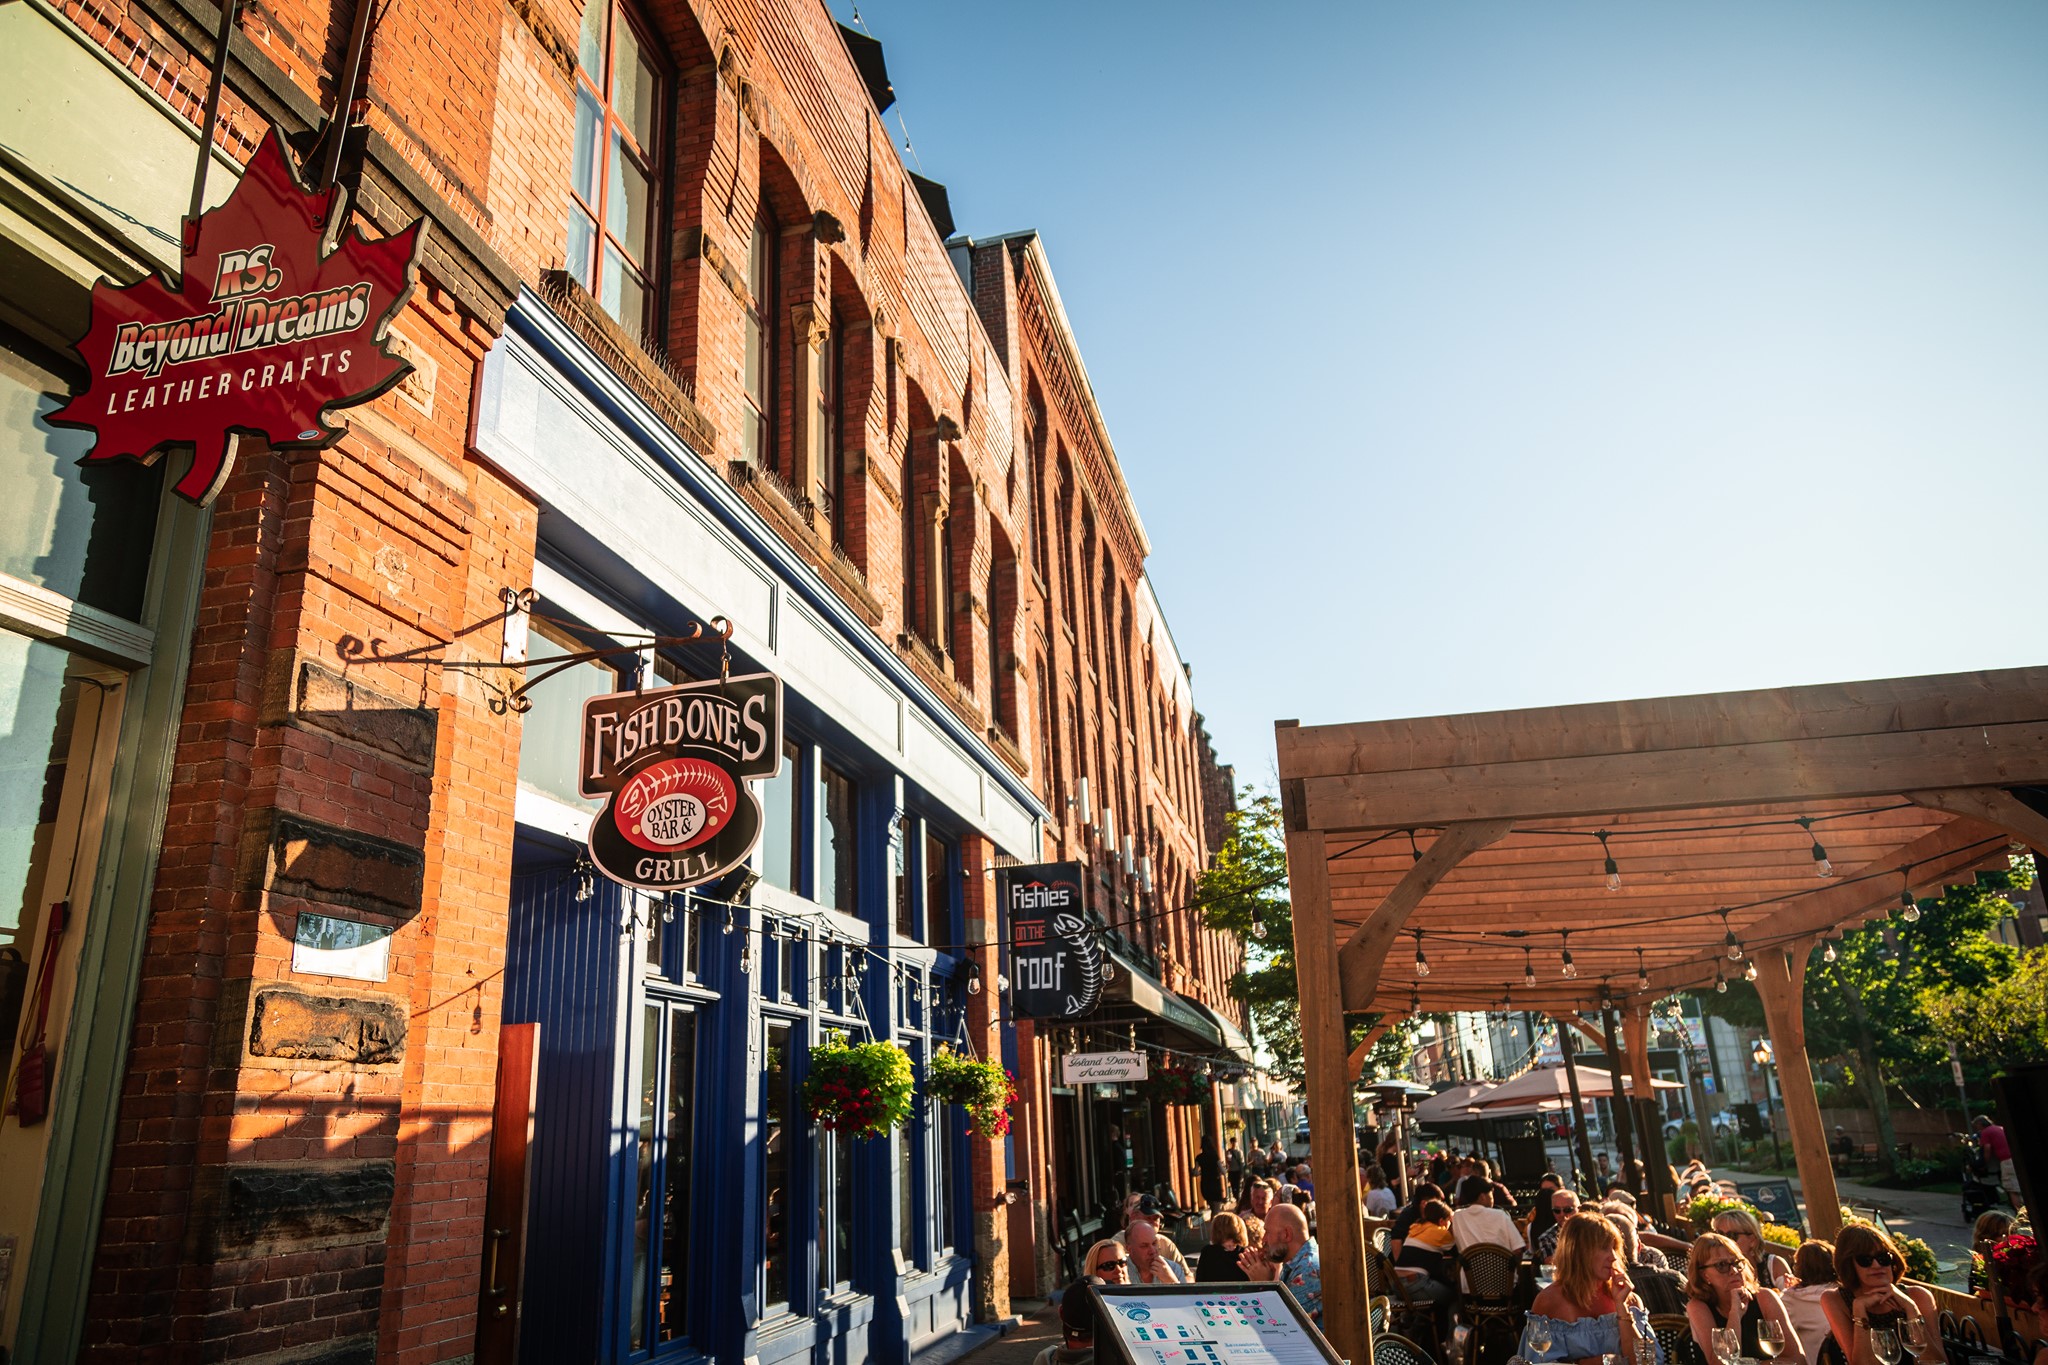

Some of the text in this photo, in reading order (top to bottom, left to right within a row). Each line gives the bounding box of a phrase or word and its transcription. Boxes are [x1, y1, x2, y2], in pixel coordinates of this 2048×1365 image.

[211, 245, 282, 302] RS.
[107, 284, 371, 377] Beyond Dreams
[647, 800, 697, 824] OYSTER
[652, 817, 693, 840] BAR &
[635, 852, 718, 882] GRILL
[1012, 884, 1069, 910] Fishies
[1028, 925, 1046, 940] THE
[1016, 952, 1067, 991] roof
[1068, 1057, 1103, 1067] Island
[1078, 1067, 1130, 1078] Academy
